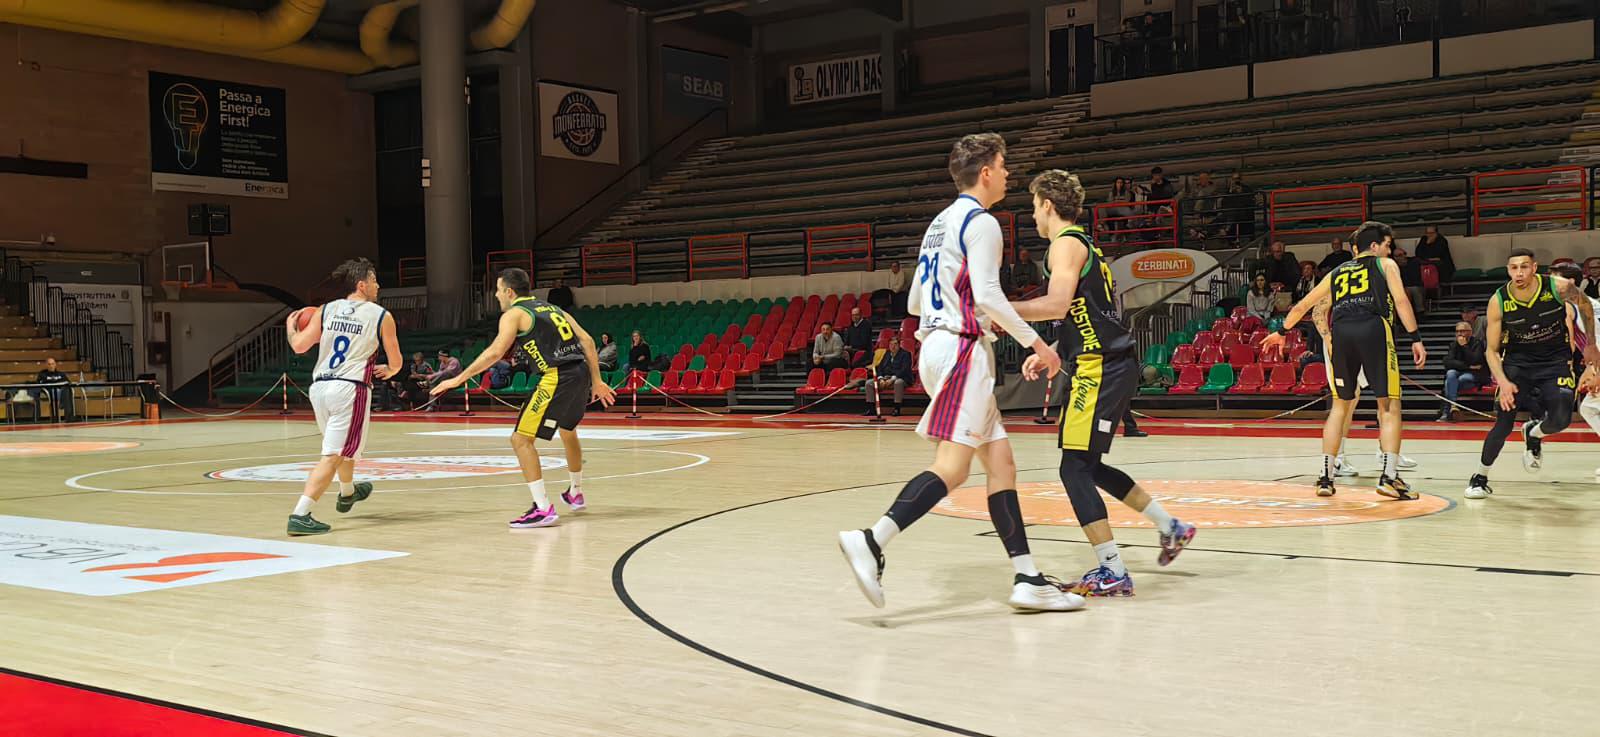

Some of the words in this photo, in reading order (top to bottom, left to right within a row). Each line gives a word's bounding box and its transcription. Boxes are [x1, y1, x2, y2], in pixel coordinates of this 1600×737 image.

[683, 75, 725, 98] SEAB
[816, 60, 861, 98] OLYMPIA
[219, 88, 253, 103] Passa
[255, 95, 262, 105] a
[219, 100, 272, 118] Energica
[220, 113, 250, 128] First!
[554, 112, 605, 137] MONFERRATO
[1136, 259, 1188, 272] ZERBINATI
[1335, 268, 1370, 302] 33
[1503, 299, 1519, 313] 00
[327, 320, 364, 336] JUNIOR
[549, 311, 574, 342] 8
[1071, 296, 1102, 353] COSTONE
[328, 335, 351, 370] 8
